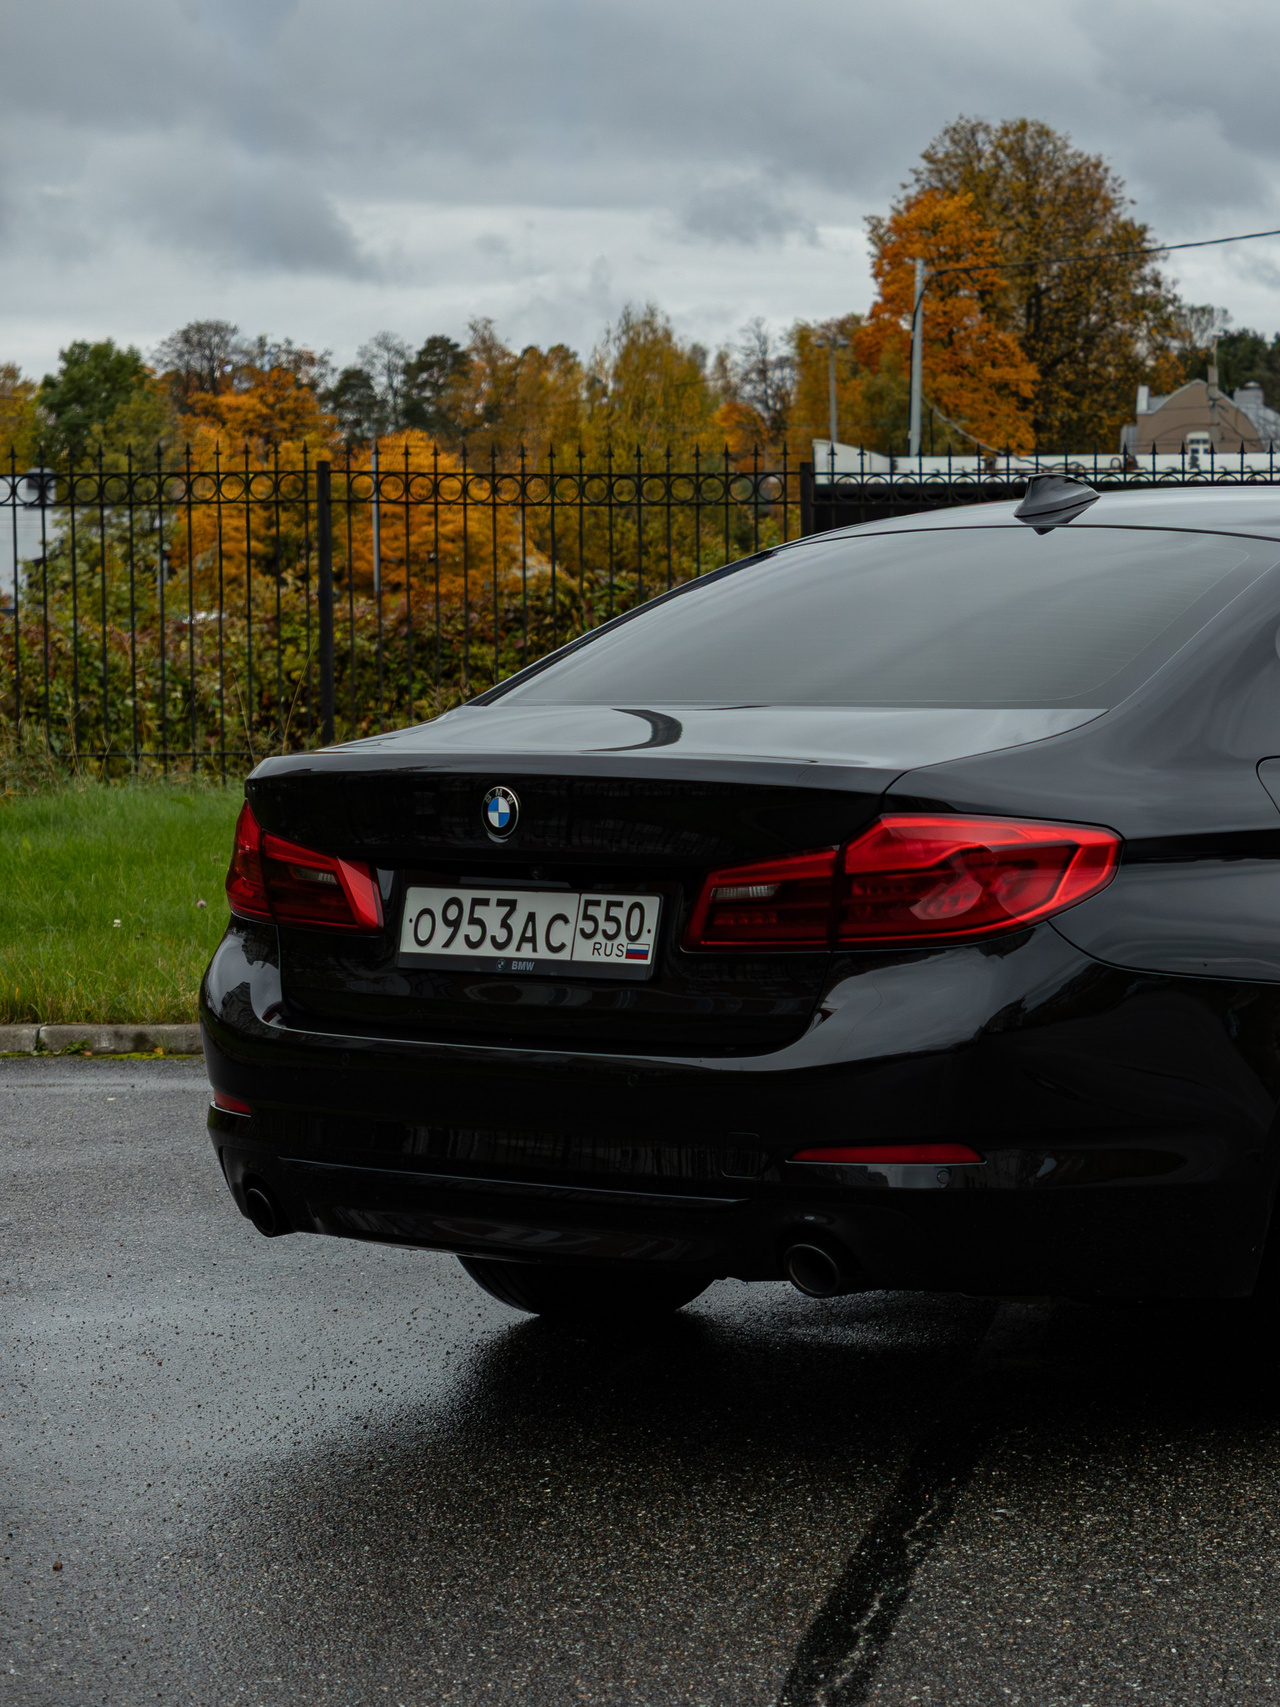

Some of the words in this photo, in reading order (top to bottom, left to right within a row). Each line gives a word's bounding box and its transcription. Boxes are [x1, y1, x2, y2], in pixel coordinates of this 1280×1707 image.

[484, 788, 515, 805] BMW
[579, 899, 646, 942] 550
[591, 942, 625, 957] RUS
[511, 960, 535, 971] BMW
